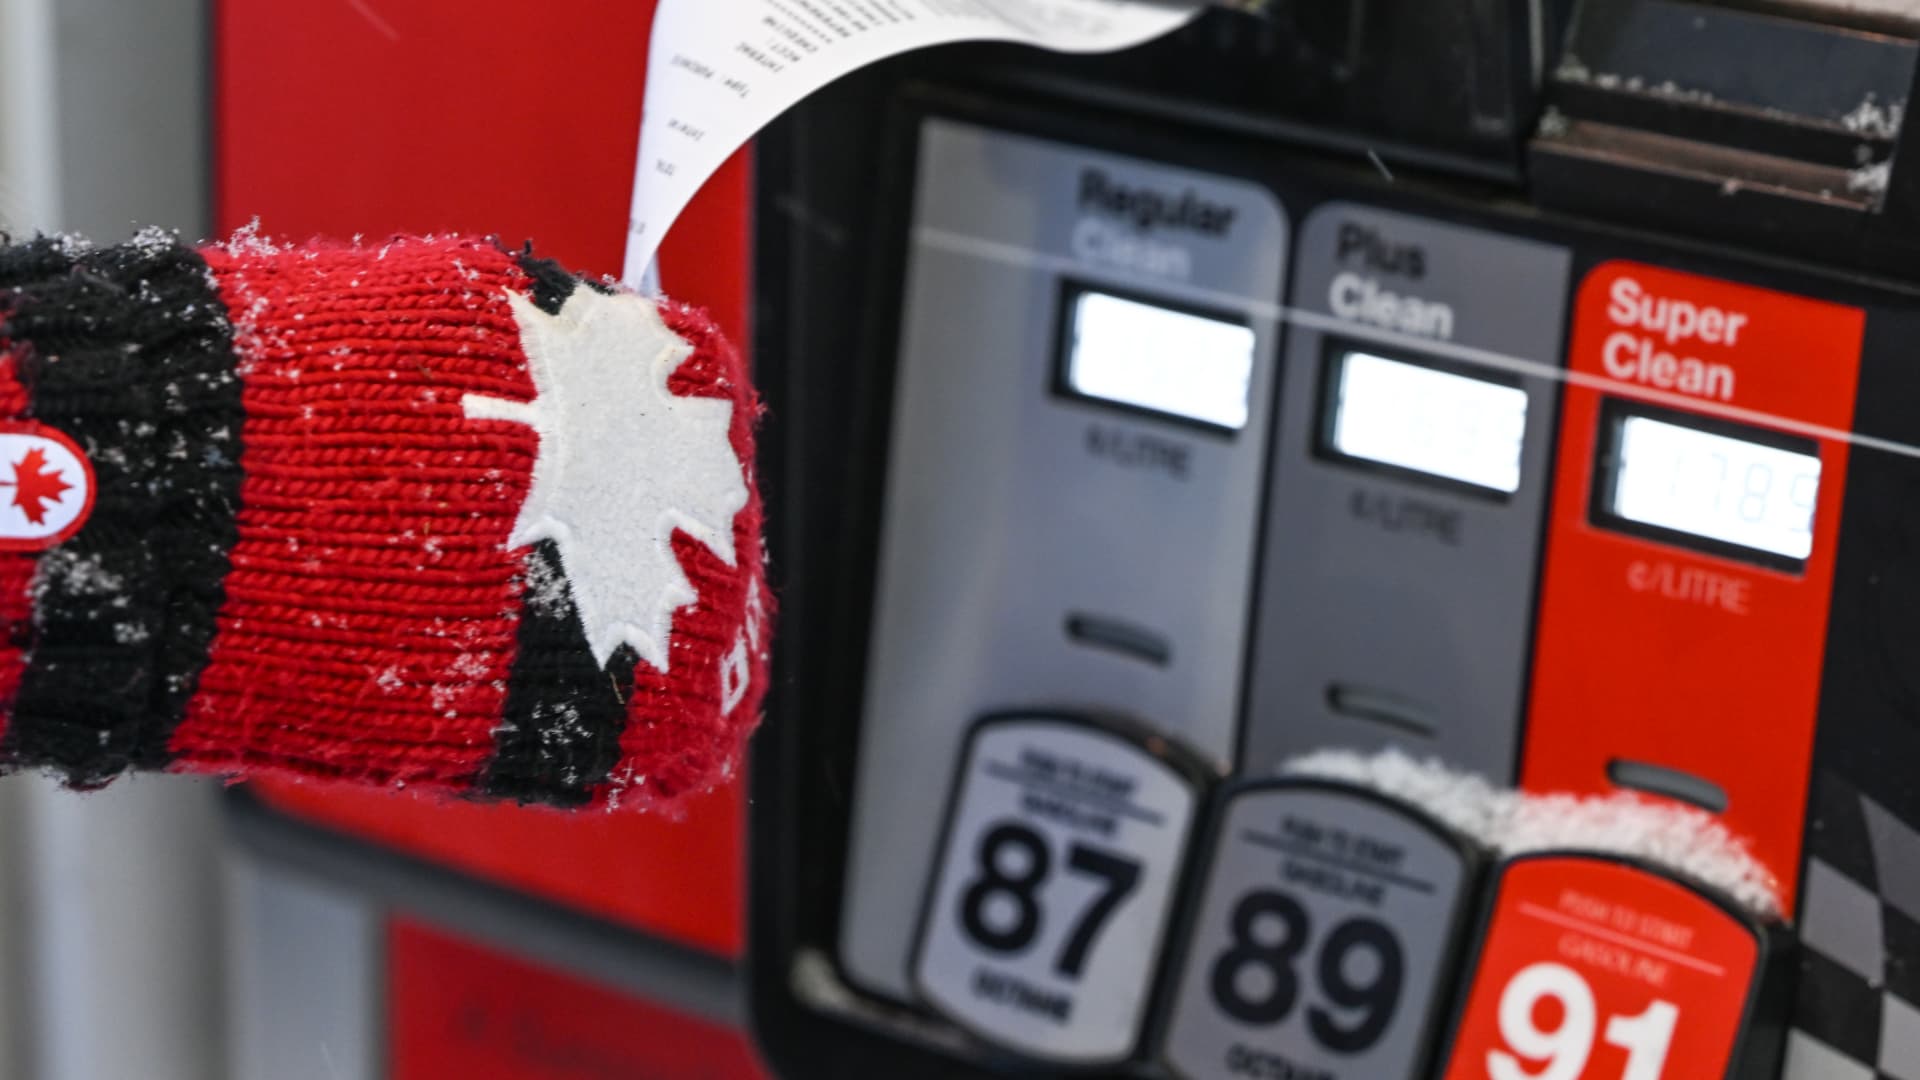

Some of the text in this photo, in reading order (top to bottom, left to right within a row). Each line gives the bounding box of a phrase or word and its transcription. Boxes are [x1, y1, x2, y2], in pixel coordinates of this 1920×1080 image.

[1078, 168, 1236, 238] Regular
[1072, 217, 1190, 277] Clean
[1336, 222, 1427, 277] Plus
[1329, 272, 1454, 339] Clean
[1608, 278, 1747, 346] Super
[1602, 333, 1735, 399] Clean
[957, 817, 1146, 982] 87
[1209, 887, 1407, 1056] 89
[1485, 961, 1680, 1080] 91
